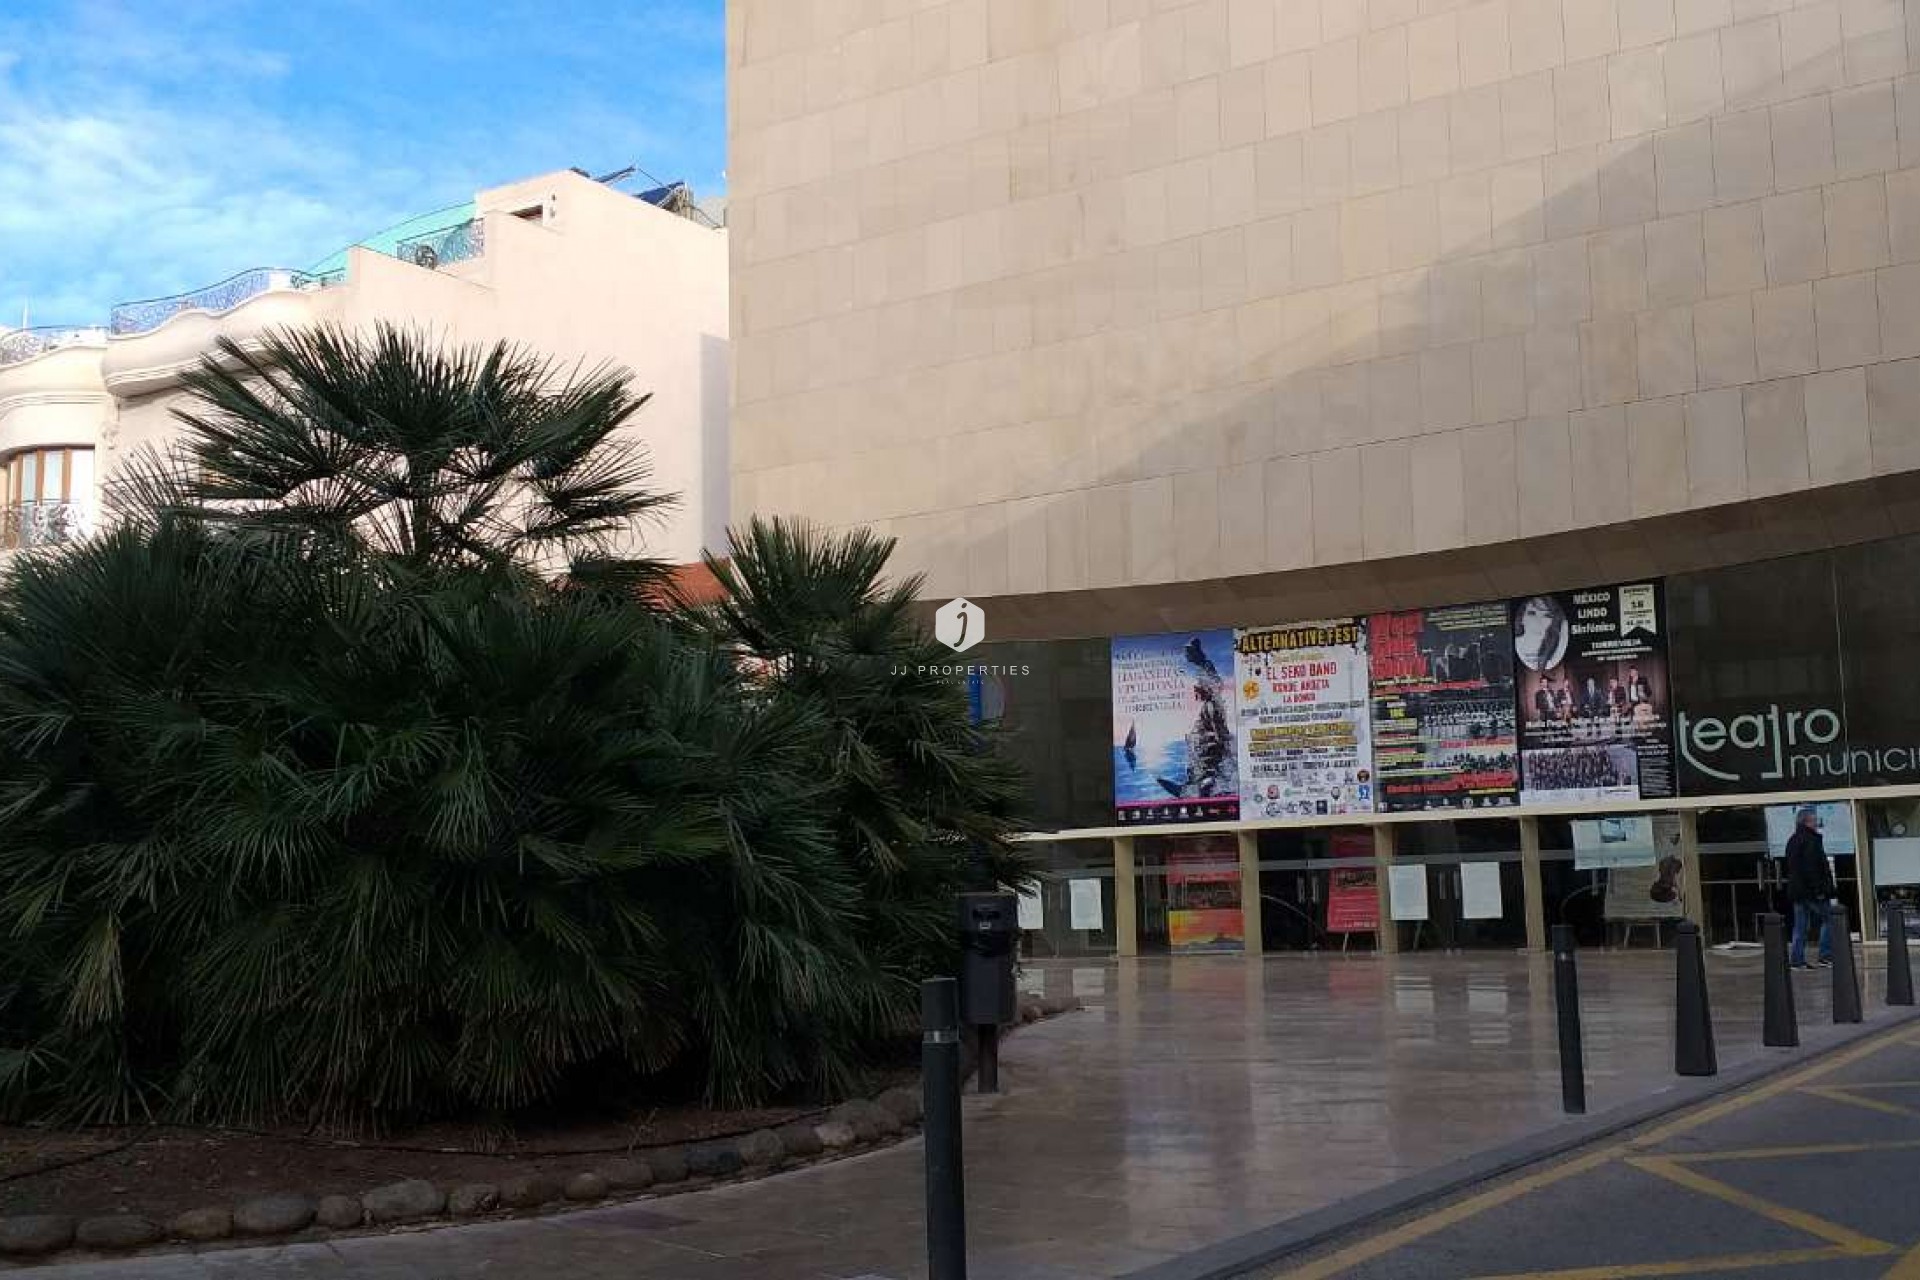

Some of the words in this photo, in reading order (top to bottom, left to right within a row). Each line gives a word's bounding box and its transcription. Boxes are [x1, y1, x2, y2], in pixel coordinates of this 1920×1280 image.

[1573, 591, 1611, 604] MÉXICO
[1578, 607, 1608, 619] LINDO
[1241, 629, 1326, 653] ALTERNATIVE
[1327, 625, 1358, 645] FEST
[1267, 666, 1279, 680] EL
[1678, 703, 1840, 781] teatro
[1790, 747, 1920, 777] munici
